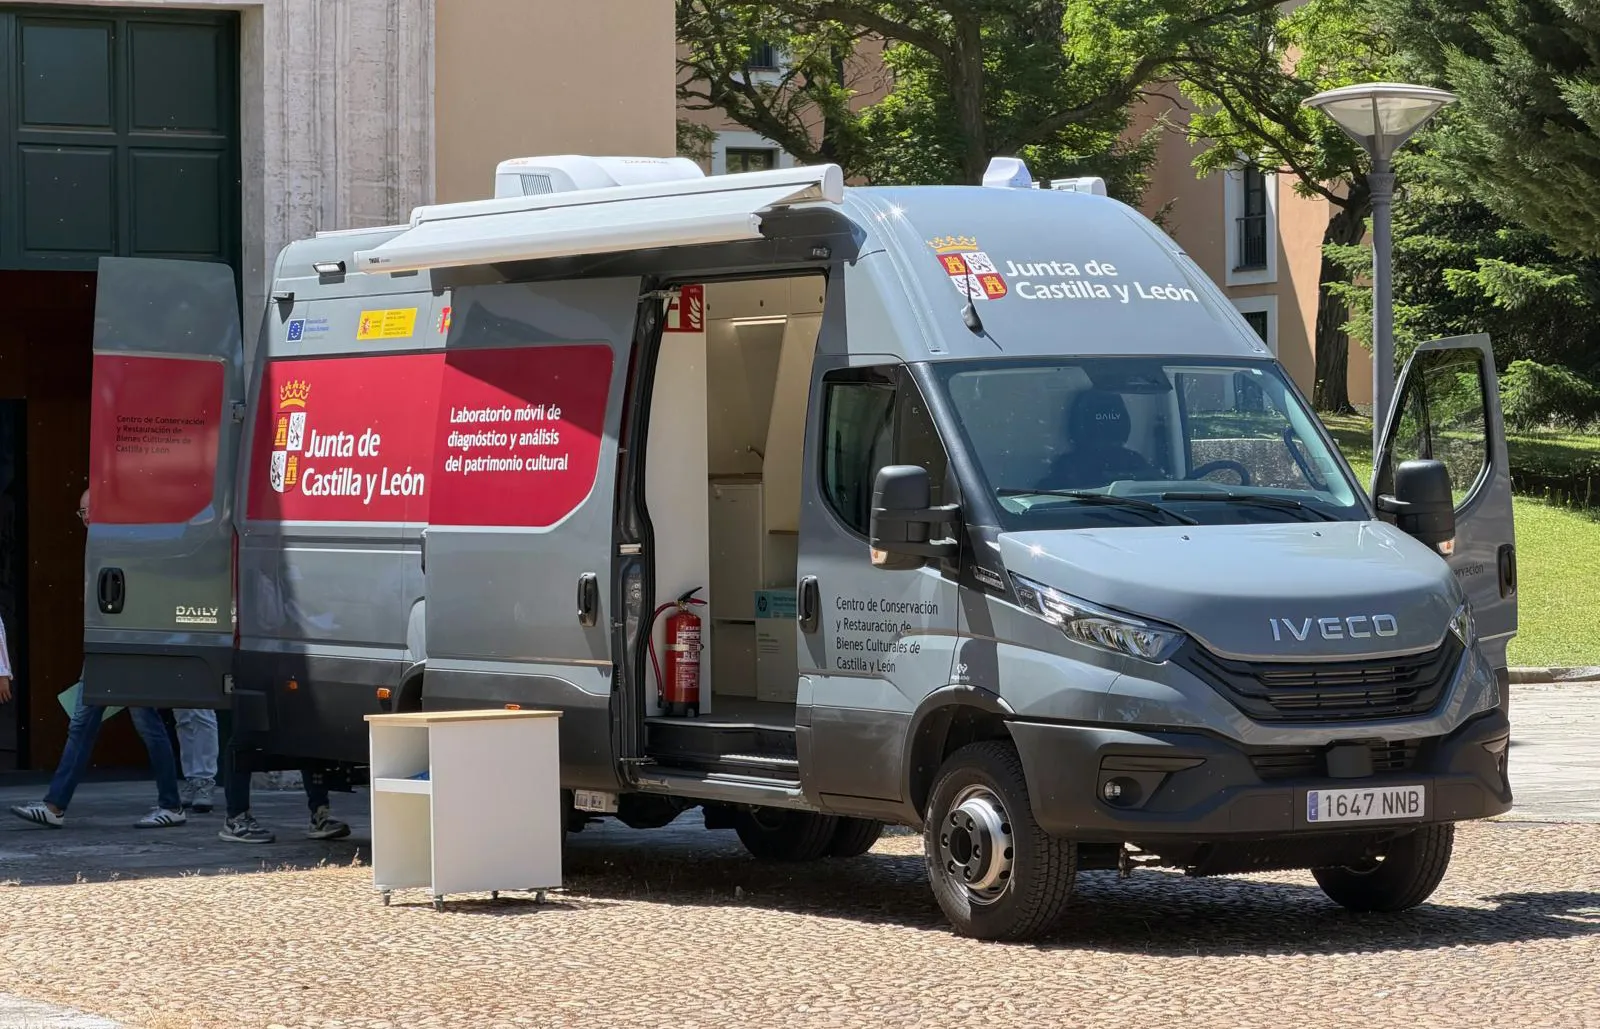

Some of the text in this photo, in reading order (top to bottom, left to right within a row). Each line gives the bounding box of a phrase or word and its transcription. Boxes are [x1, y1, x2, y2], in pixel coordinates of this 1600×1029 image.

[1006, 260, 1118, 277] Junta de
[1015, 281, 1199, 303] Castilla y León
[116, 415, 142, 423] Centro
[450, 404, 561, 423] Laboratorio móvil de
[304, 428, 381, 458] Junta de
[448, 428, 560, 452] diagnóstico y análisis
[445, 453, 568, 476] del patrimonio cultural
[302, 466, 424, 505] Castilla y León
[1453, 561, 1484, 577] ervación
[176, 606, 218, 616] DAILY
[836, 596, 938, 614] Centro de Conservación
[836, 618, 911, 632] y Restauración de
[1269, 614, 1398, 641] IVECO
[836, 637, 920, 654] Bienes Culturales de
[836, 656, 896, 673] Castilla y León
[1326, 793, 1374, 818] 1647
[1382, 791, 1419, 815] NNB
